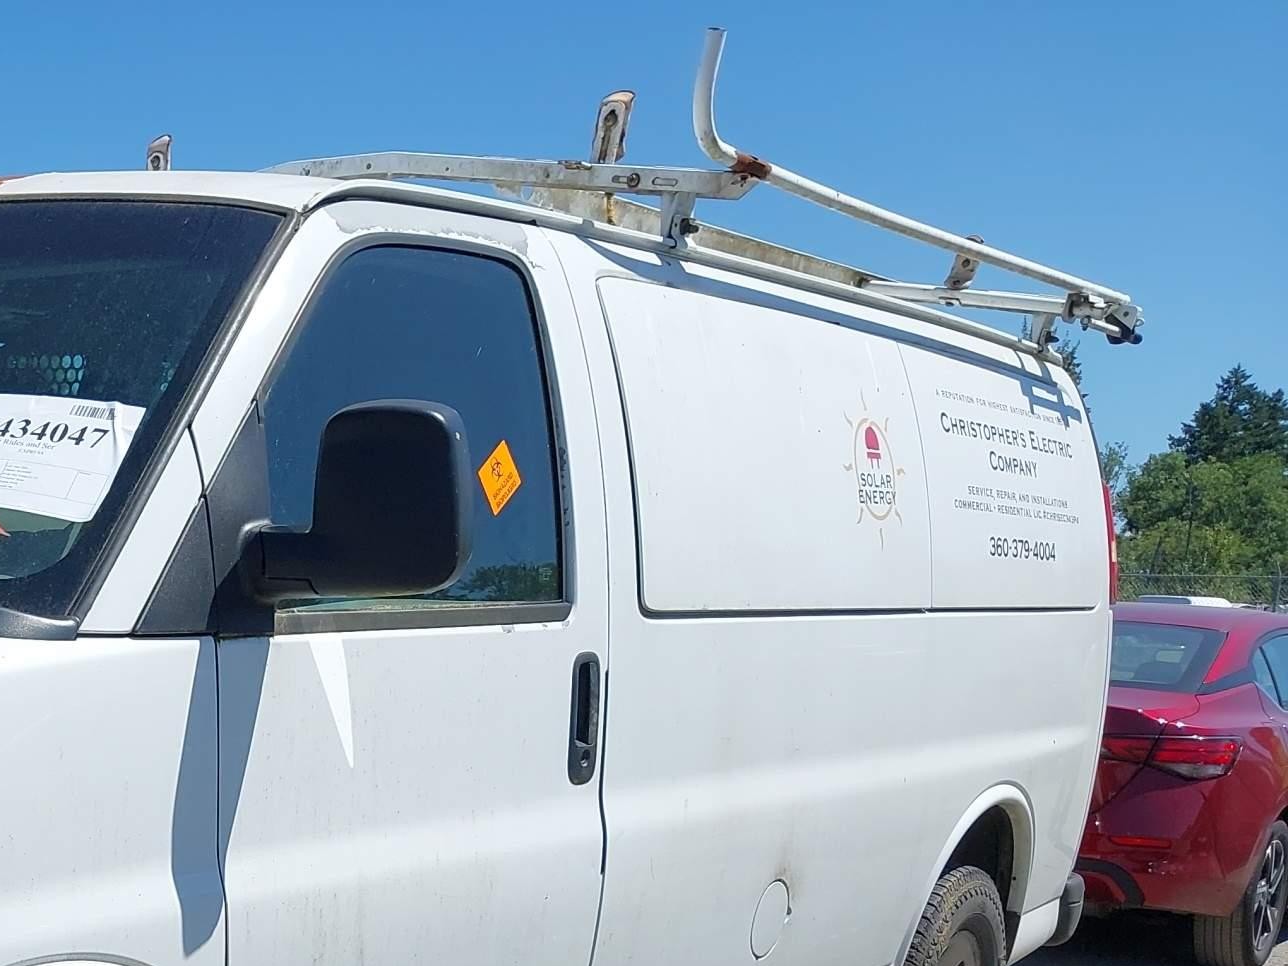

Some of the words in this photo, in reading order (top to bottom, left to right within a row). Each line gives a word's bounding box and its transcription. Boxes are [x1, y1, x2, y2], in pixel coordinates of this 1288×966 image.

[3, 438, 24, 447] Rides
[25, 440, 42, 449] and
[940, 411, 1027, 449] CHRISTOPHER'S
[1028, 430, 1073, 459] ELECTRIC
[989, 450, 1038, 479] COMPANY
[860, 472, 893, 488] SOLAR
[858, 489, 897, 505] ENERGY
[967, 485, 996, 500] SERVICE,
[1018, 493, 1030, 503] AND
[954, 498, 993, 513] COMMERCIAL
[997, 504, 1032, 518] RESIDENTIAL
[989, 536, 1056, 561] 360-379-4004
